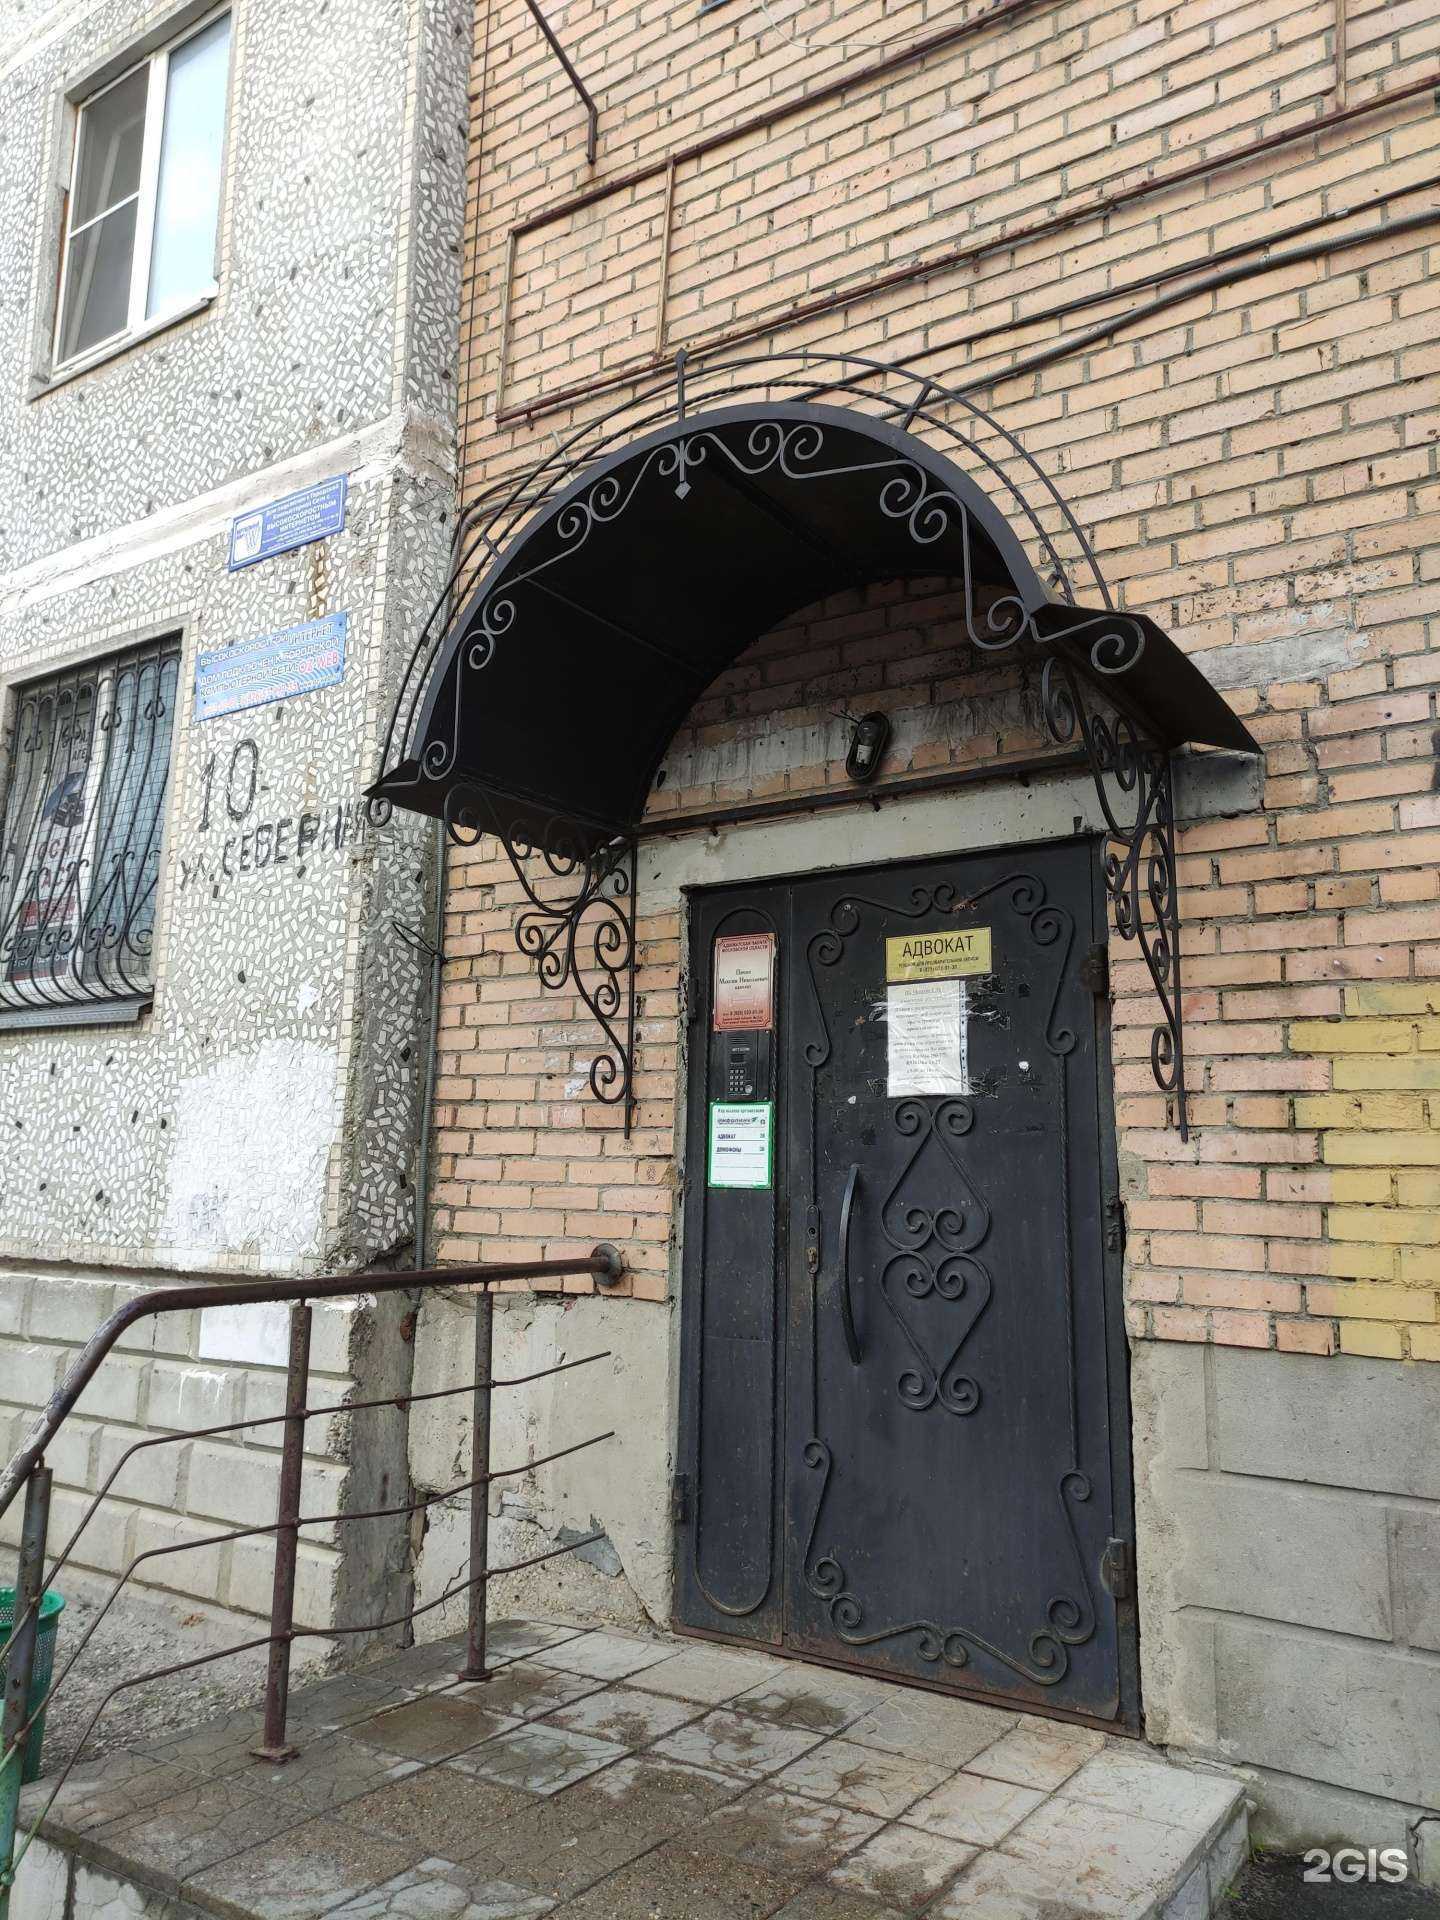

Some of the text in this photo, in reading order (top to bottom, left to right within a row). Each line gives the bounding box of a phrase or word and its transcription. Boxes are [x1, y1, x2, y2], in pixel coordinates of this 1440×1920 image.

[267, 500, 336, 530] ВЫСОКОСКОРОСТНЫМ
[280, 513, 320, 532] ИНТЕРНЕТОМ
[288, 623, 333, 645] ИНТЕРНЕТ
[200, 673, 219, 686] ДОМ
[284, 636, 338, 661] ГОРОДСКОЙ
[200, 669, 268, 697] КОМПЬЮТЕРНОЙ
[180, 853, 215, 891] ул.
[903, 936, 974, 959] АДВОКАТ
